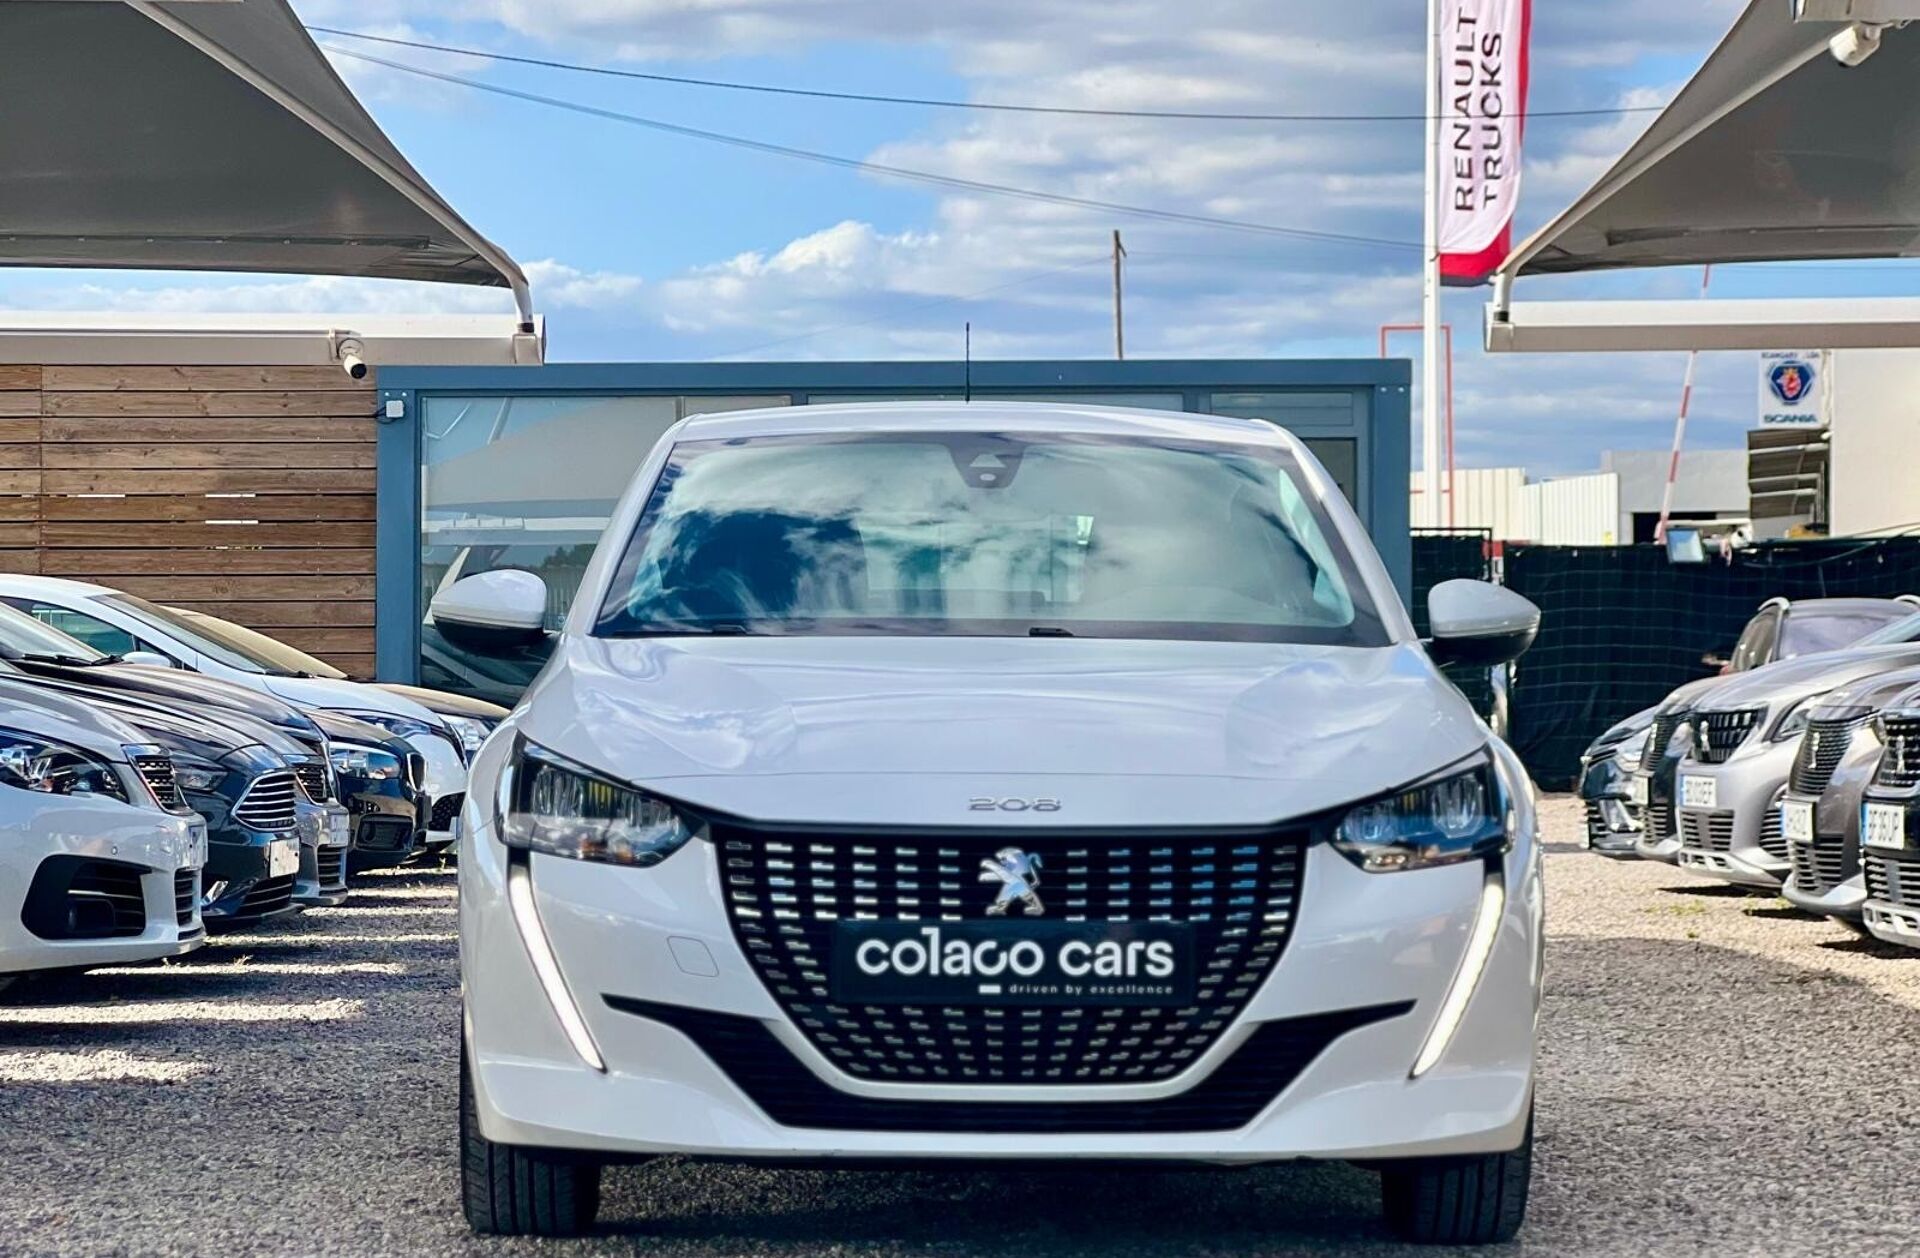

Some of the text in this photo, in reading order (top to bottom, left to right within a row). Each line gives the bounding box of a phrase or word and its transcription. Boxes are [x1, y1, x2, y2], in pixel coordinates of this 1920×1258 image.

[1453, 7, 1477, 211] RENAULT
[1480, 32, 1502, 210] TRUCKS
[1764, 414, 1818, 424] SCANIA
[968, 797, 1062, 812] 208
[1058, 940, 1174, 977] cars
[1009, 983, 1174, 996] driven by excellence
